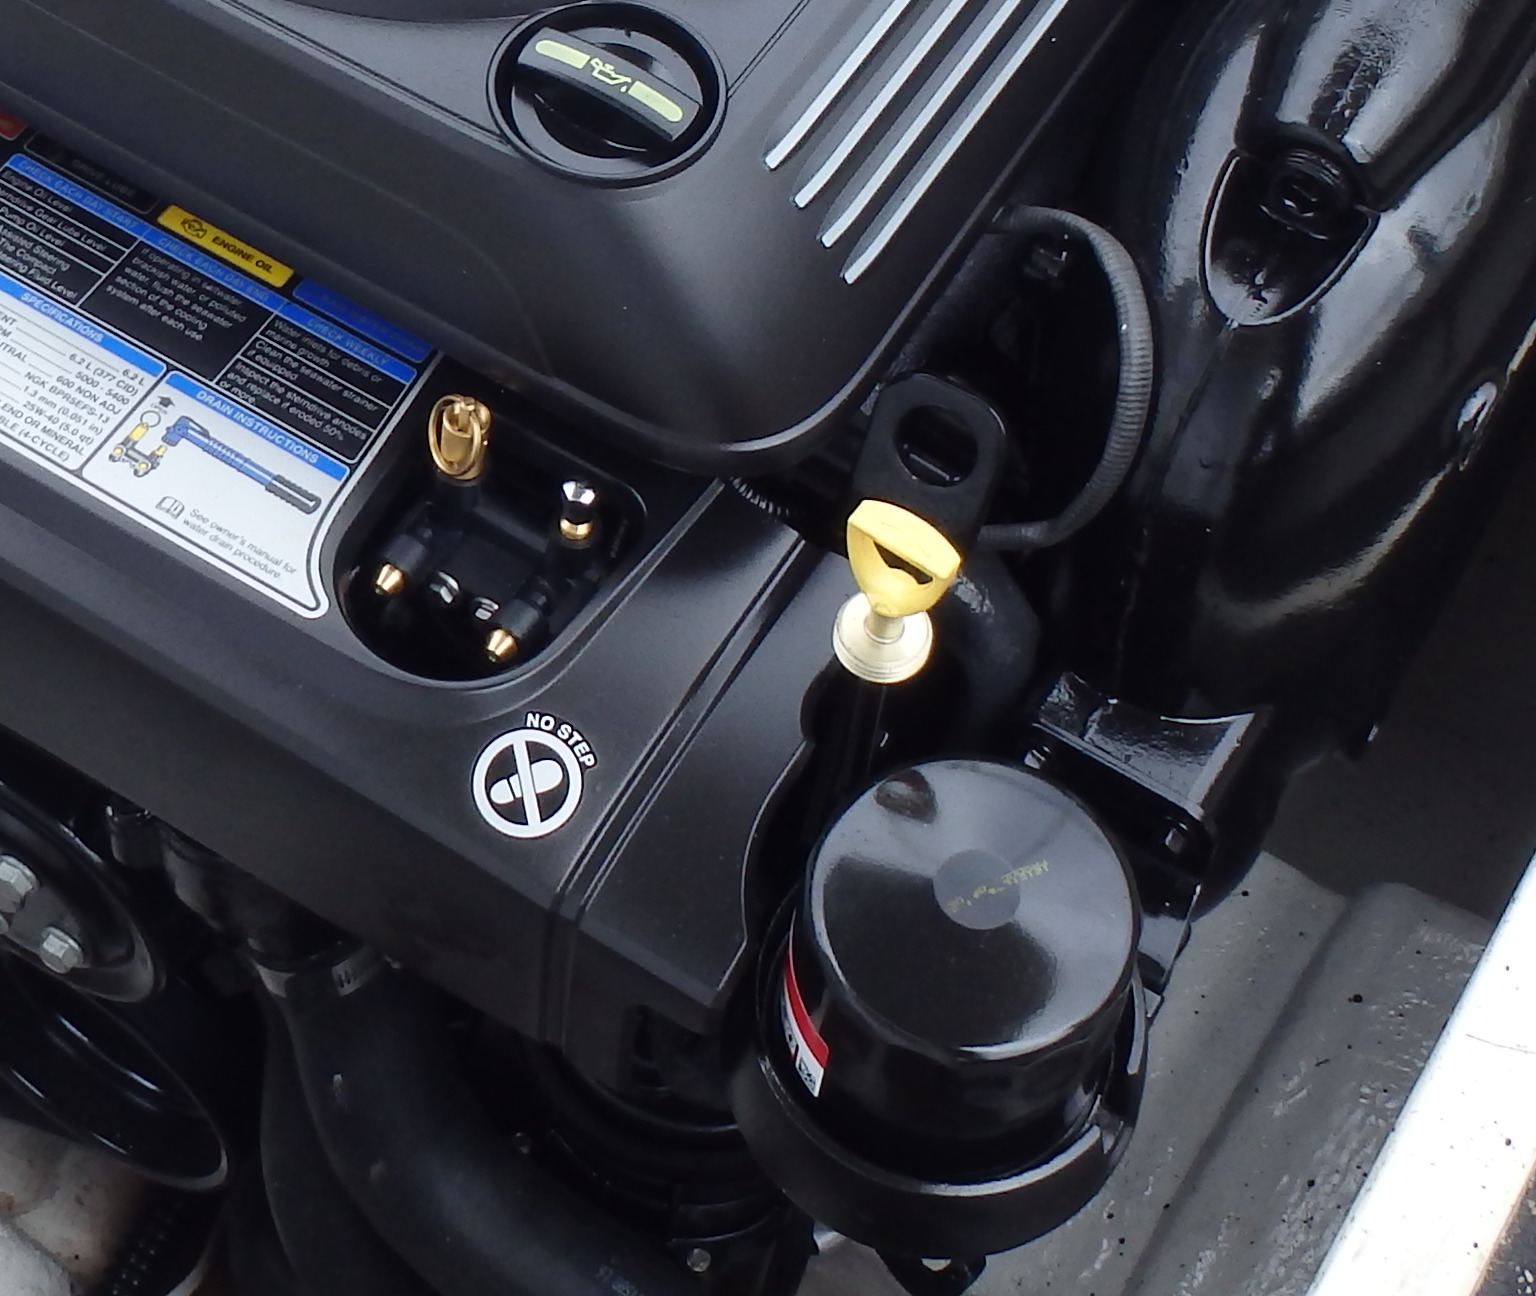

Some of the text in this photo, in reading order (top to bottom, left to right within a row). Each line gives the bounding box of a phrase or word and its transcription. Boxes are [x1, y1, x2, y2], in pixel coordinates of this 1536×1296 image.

[33, 207, 58, 224] Gear
[56, 221, 81, 237] Lube
[80, 234, 107, 251] Level
[39, 229, 65, 246] Level
[15, 248, 57, 275] Compact
[31, 245, 70, 271] Steering
[211, 235, 274, 273] ENGINE OIL
[27, 268, 52, 285] Fluid
[50, 280, 77, 299] Level
[114, 275, 148, 296] section
[158, 298, 175, 311] the
[173, 307, 208, 331] cooling
[20, 291, 104, 342] SPECIFICATIONS
[105, 284, 185, 331] system after each
[92, 366, 116, 382] (377
[115, 379, 139, 396] CID)
[121, 368, 139, 381] 6.2
[253, 353, 298, 381] equipped
[254, 339, 378, 412] Clean the seawater strainer
[23, 371, 48, 388] NGK
[48, 385, 110, 423] BPR5EFS-13
[55, 375, 75, 388] 600
[74, 385, 100, 403] NON
[98, 399, 121, 415] ADJ
[74, 371, 100, 388] 5000
[104, 388, 130, 405] 5400
[226, 371, 247, 385] and
[245, 381, 281, 405] replace
[288, 406, 323, 428] eroded
[321, 424, 345, 441] 50%
[229, 385, 257, 405] more.
[234, 361, 367, 440] Inspect the sterndrive anodes
[22, 400, 60, 425] 25W-40
[58, 421, 79, 436] (5.0
[77, 433, 95, 446] qt)
[23, 415, 41, 428] OR
[40, 425, 85, 455] MINERAL
[37, 395, 57, 409] mm
[56, 406, 88, 426] (0.051
[87, 423, 103, 436] in)
[195, 389, 319, 464] DRAIN INSTRUCTIONS
[17, 428, 70, 462] (4-CYCLE)
[188, 508, 210, 524] See
[208, 521, 247, 546] owner's
[246, 542, 283, 566] manual
[526, 712, 596, 767] NO STEP
